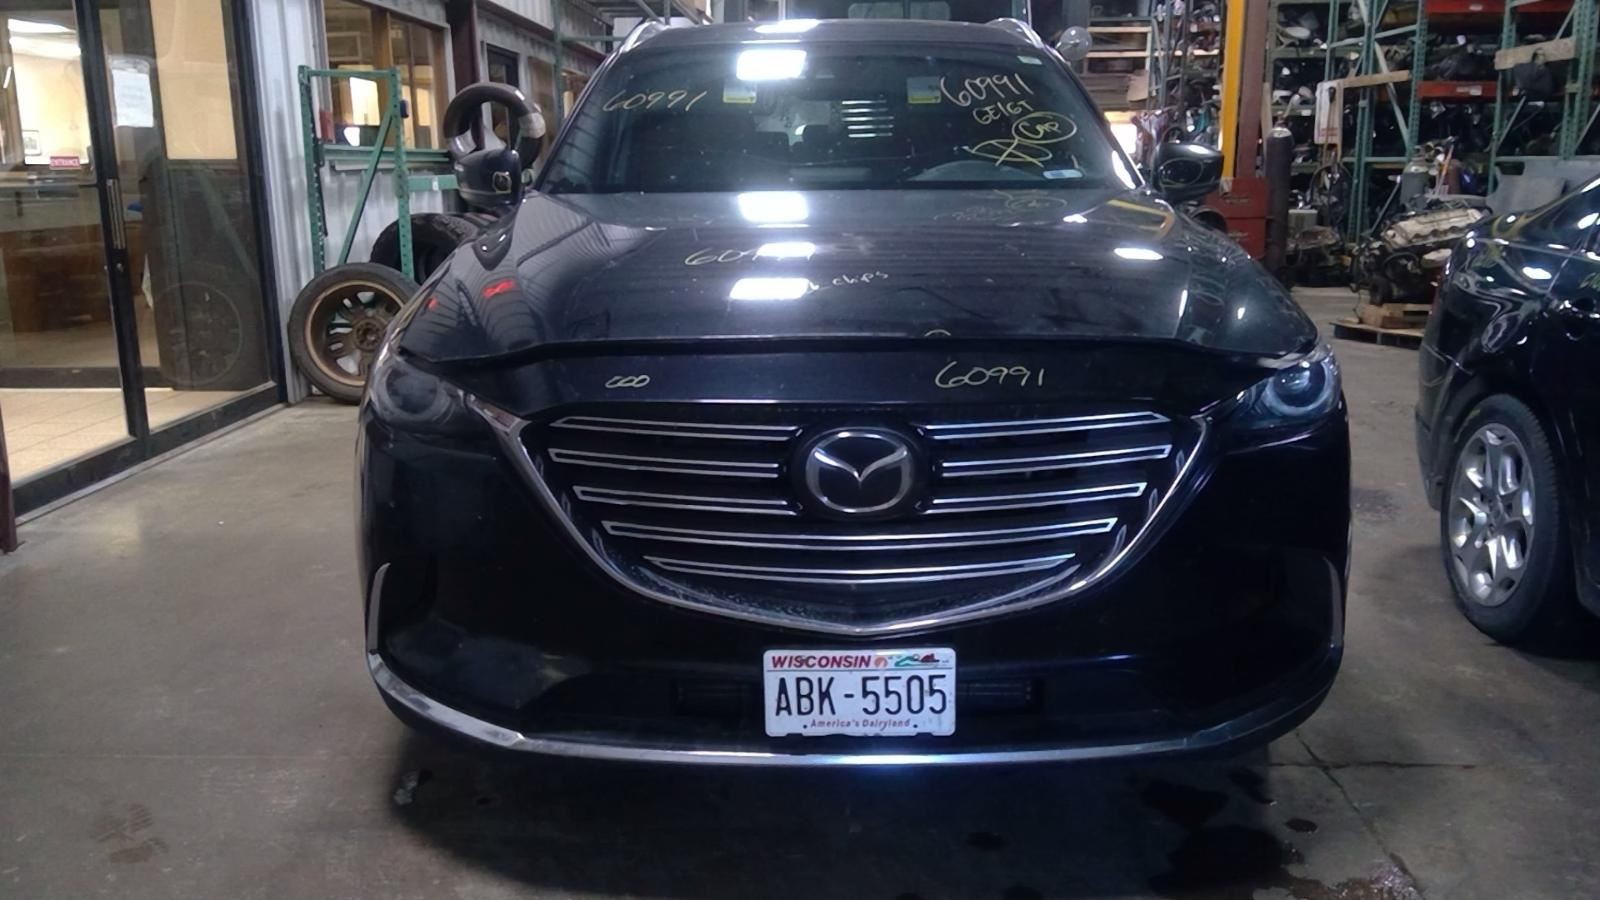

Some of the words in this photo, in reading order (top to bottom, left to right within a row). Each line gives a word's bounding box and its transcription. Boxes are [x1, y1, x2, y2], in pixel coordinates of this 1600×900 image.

[602, 89, 708, 112] 60991
[940, 73, 1034, 107] 60991
[935, 361, 1045, 389] 60991
[771, 655, 871, 668] WISCONSIN
[775, 674, 947, 716] ABK-5505
[810, 718, 860, 728] America's
[861, 718, 911, 731] Dairyland
